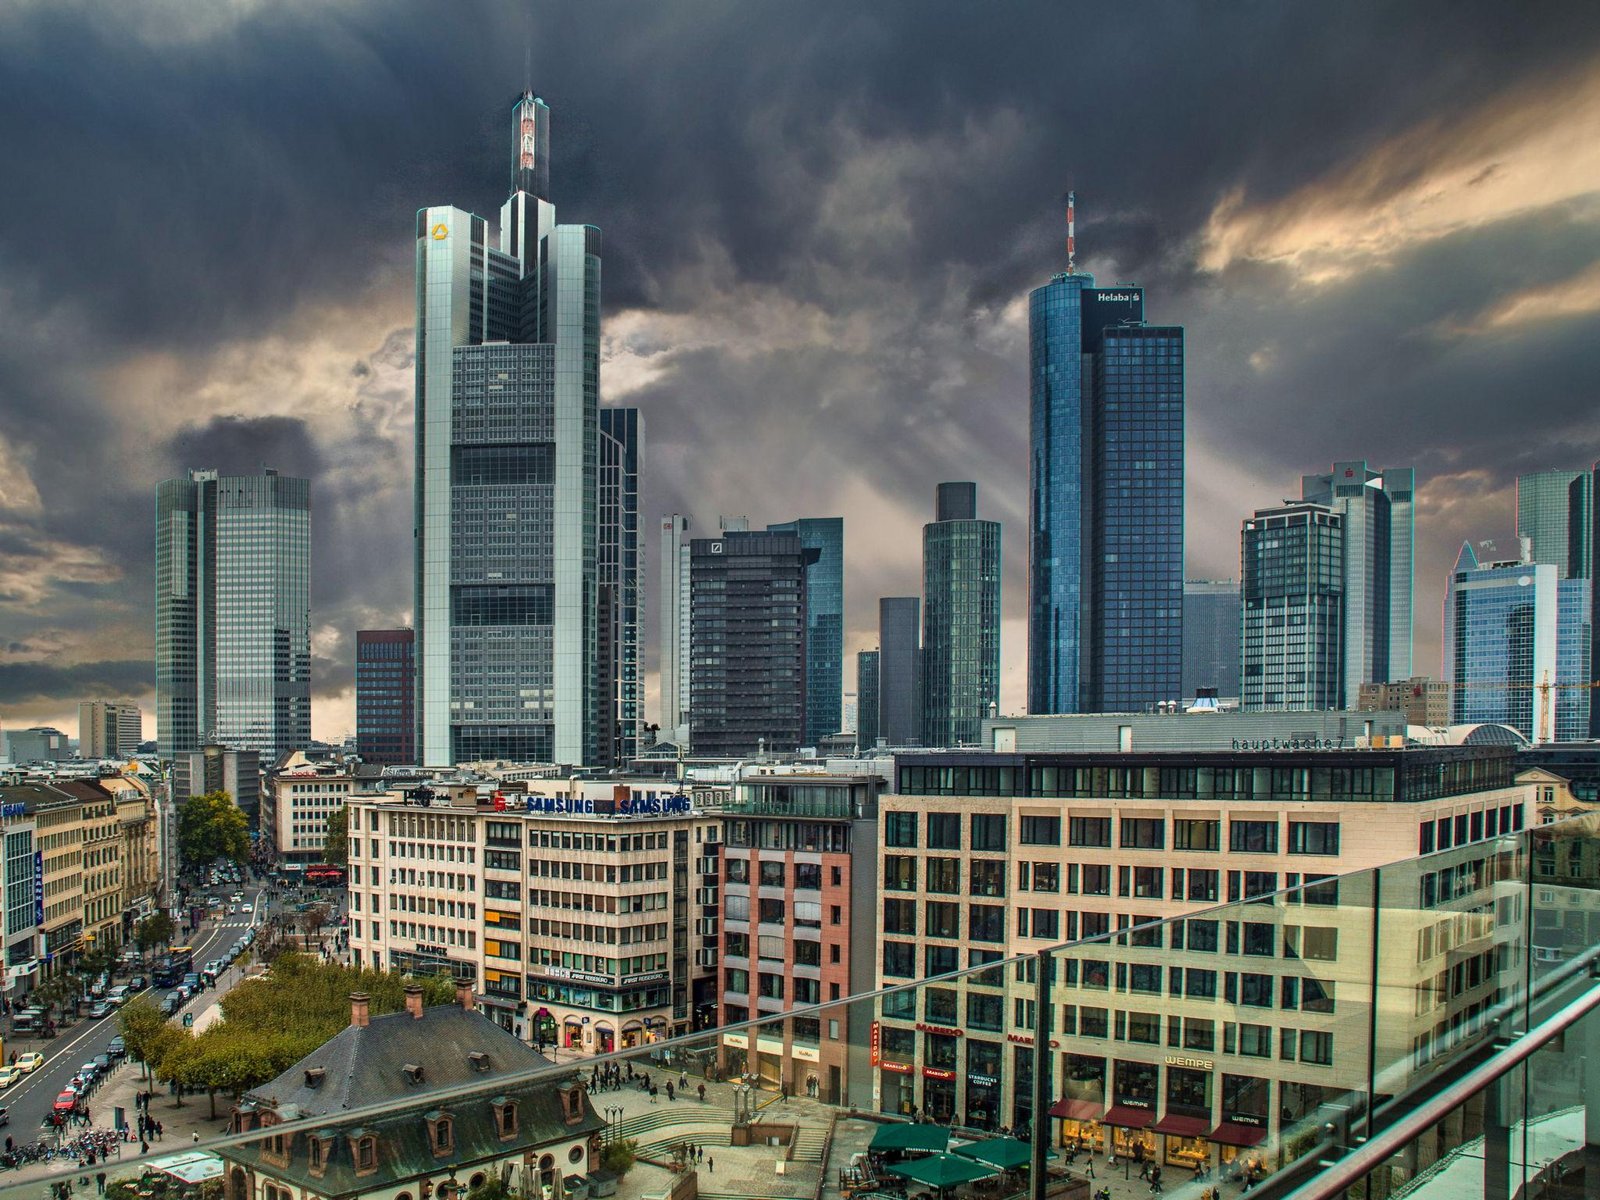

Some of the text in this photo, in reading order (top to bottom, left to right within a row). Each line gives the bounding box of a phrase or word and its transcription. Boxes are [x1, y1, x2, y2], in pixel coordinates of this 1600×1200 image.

[1098, 293, 1129, 302] Helaba
[527, 797, 593, 813] SAMSUNG
[620, 796, 690, 814] SAMSUNG
[915, 1023, 964, 1037] MAREDO
[1007, 1034, 1060, 1048] MARO
[883, 1062, 907, 1071] MAREDO
[1165, 1056, 1213, 1069] WEMPE
[926, 1069, 949, 1078] MAREDO
[968, 1074, 997, 1083] STARBUCKS
[973, 1079, 992, 1087] COFFEE
[1122, 1099, 1148, 1108] WEMPE
[1231, 1115, 1259, 1125] WEMPE
